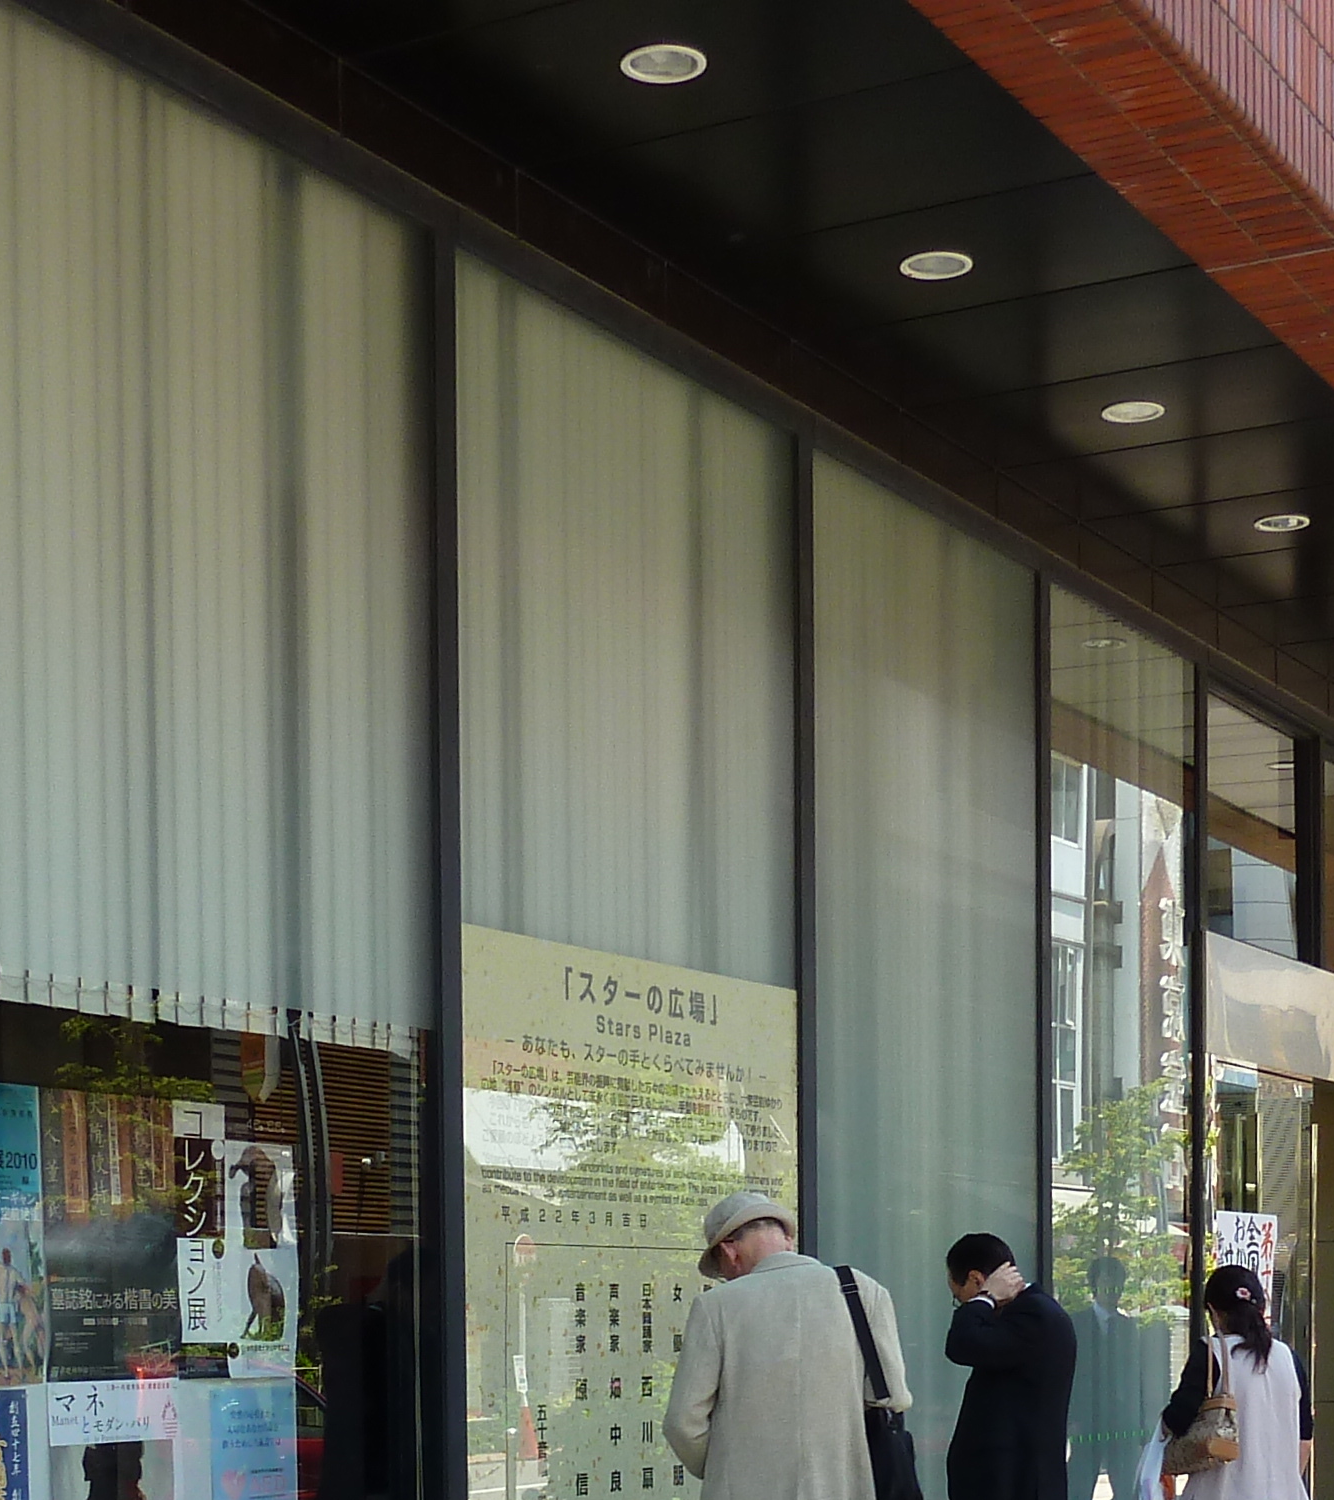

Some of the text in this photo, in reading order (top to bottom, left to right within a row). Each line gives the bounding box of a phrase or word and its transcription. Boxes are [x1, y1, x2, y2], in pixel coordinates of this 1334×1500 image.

[564, 966, 717, 1026] 「スターの広場」
[596, 1014, 691, 1047] Stars Plaza
[481, 1168, 522, 1181] contribute
[524, 1171, 532, 1182] to
[533, 1172, 546, 1183] the
[602, 1176, 614, 1188] the
[183, 1110, 209, 1332] コレクション展
[50, 1287, 178, 1311] 墓誌銘にみる楷書の美
[575, 1282, 587, 1354] 音楽家
[609, 1283, 620, 1353] 声楽家
[56, 1384, 105, 1416] マネ
[51, 1415, 79, 1427] Manet
